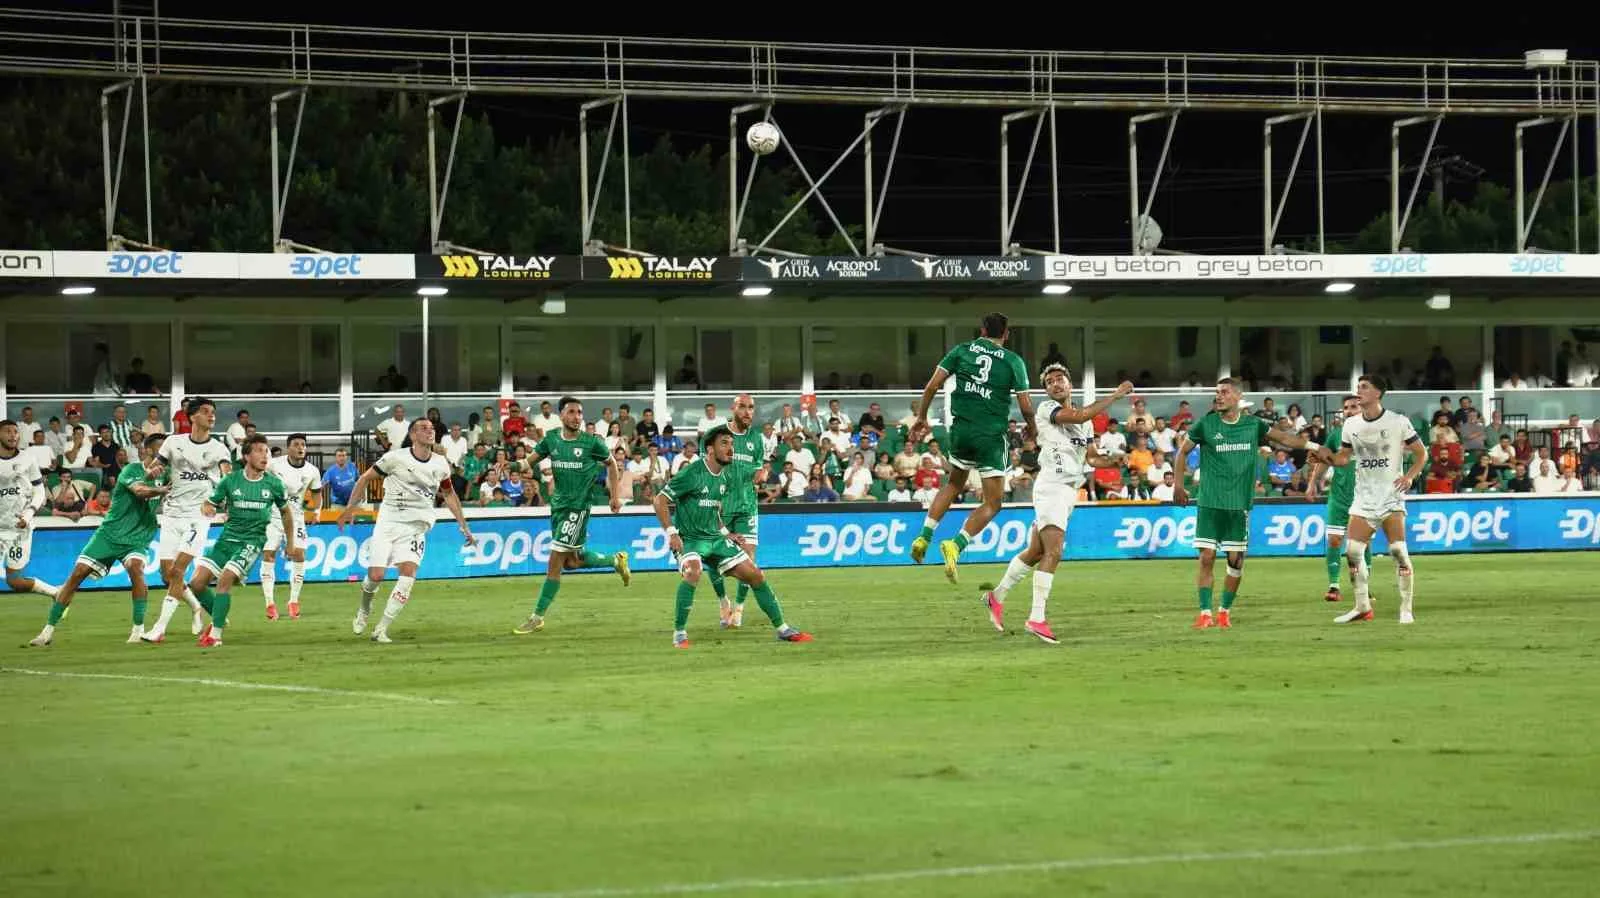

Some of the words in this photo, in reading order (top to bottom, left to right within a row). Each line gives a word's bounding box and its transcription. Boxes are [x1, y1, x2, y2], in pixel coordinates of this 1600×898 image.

[107, 252, 183, 276] opet
[290, 254, 361, 277] opet
[479, 256, 555, 271] TALAY
[643, 257, 717, 271] TALAY
[782, 265, 820, 278] AURA
[825, 260, 881, 271] ACROPOL
[935, 264, 973, 278] AURA
[976, 260, 1031, 272] ACROPOL
[1053, 260, 1107, 277] grey
[1114, 257, 1181, 273] beton
[1197, 260, 1250, 277] grey
[1258, 256, 1323, 272] beton
[1370, 255, 1427, 274] opet
[1509, 255, 1566, 274] opet
[484, 271, 551, 279] LOGISTICS
[971, 354, 993, 384] 3
[1360, 457, 1389, 469] opet
[190, 530, 197, 542] 7
[1113, 515, 1197, 553] ope
[1412, 506, 1510, 548] opet
[798, 519, 907, 561] opet
[9, 547, 23, 560] 68
[460, 530, 552, 570] ope
